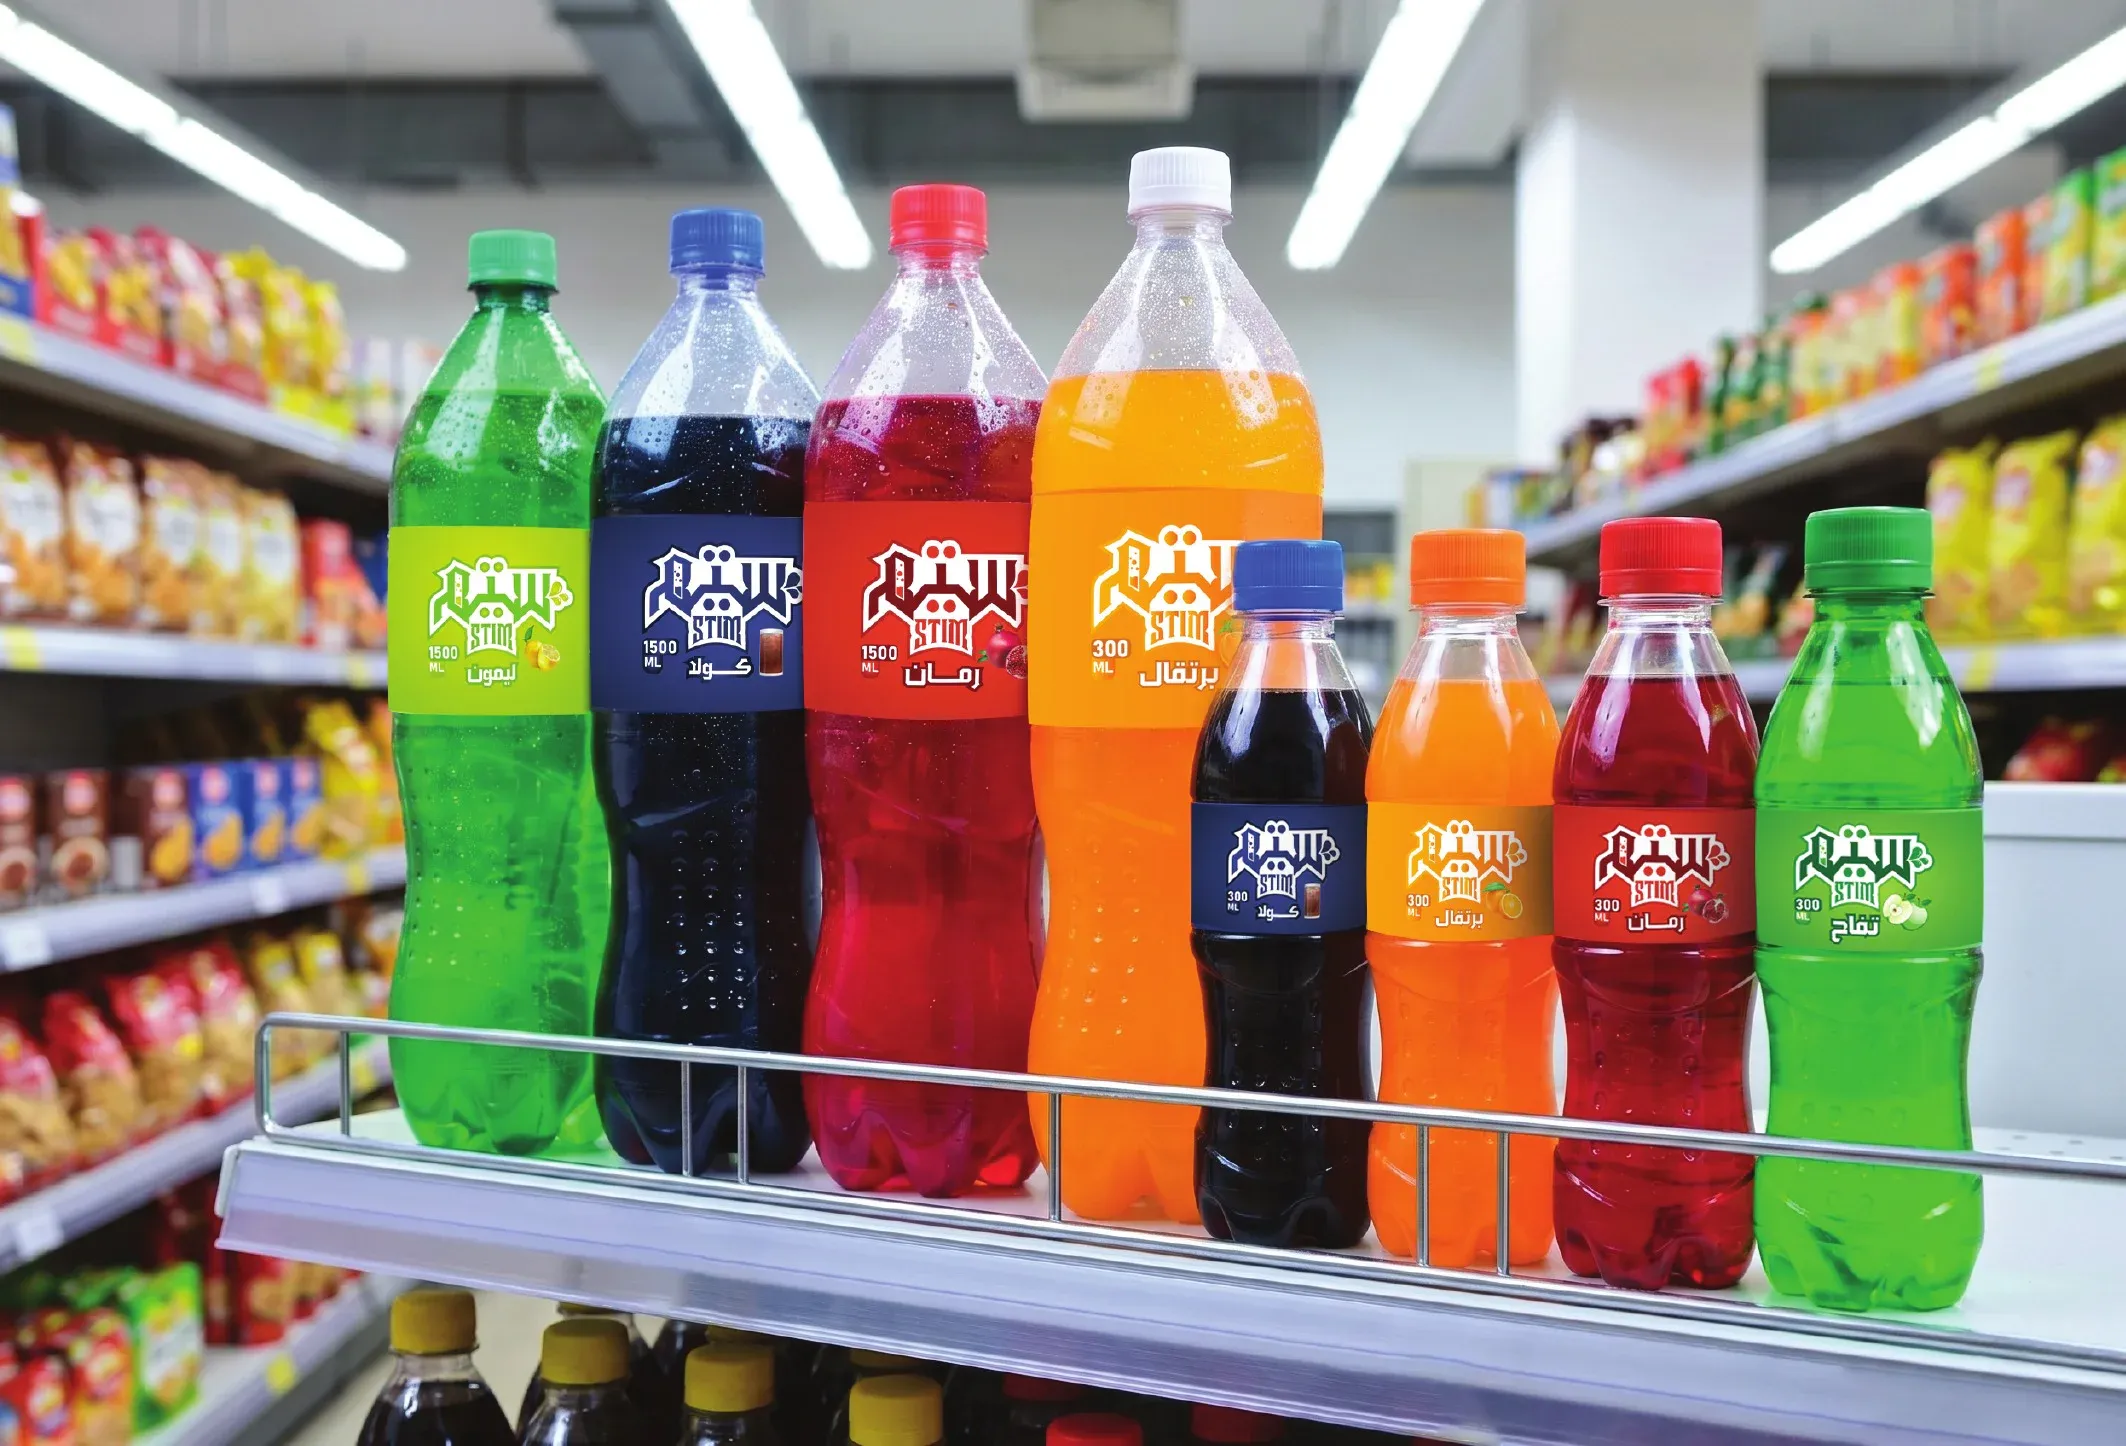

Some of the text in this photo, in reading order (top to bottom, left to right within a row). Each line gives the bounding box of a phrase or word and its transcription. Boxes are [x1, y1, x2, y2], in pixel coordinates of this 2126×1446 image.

[692, 616, 742, 645] STIM
[914, 618, 968, 649] STIM
[1150, 611, 1209, 645] STIM
[470, 622, 514, 651] STIM
[428, 646, 458, 660] 1500
[643, 640, 677, 654] 1500
[861, 645, 898, 660] 1500
[1092, 640, 1128, 657] 300
[429, 662, 445, 673] ML
[644, 657, 662, 668] ML
[688, 659, 751, 680] كولا
[861, 662, 879, 673] ML
[1093, 662, 1113, 674] ML
[467, 662, 516, 686] ليمون
[904, 662, 980, 689] رمان
[1140, 662, 1219, 690] برتقال
[1260, 874, 1293, 896] STIM
[1442, 877, 1478, 899] STIM
[1635, 880, 1674, 902] STIM
[1834, 881, 1875, 904] STIM
[1227, 891, 1248, 902] 300
[1408, 895, 1429, 907] 300
[1227, 903, 1239, 911] ML
[1258, 905, 1299, 921] كولا
[1408, 908, 1420, 917] ML
[1594, 899, 1620, 911] 300
[1795, 899, 1820, 911] 300
[1435, 909, 1483, 929] برتقال
[1594, 912, 1609, 922] ML
[1628, 913, 1684, 932] رمان
[1796, 912, 1810, 921] ML
[1831, 915, 1880, 943] تفاح
